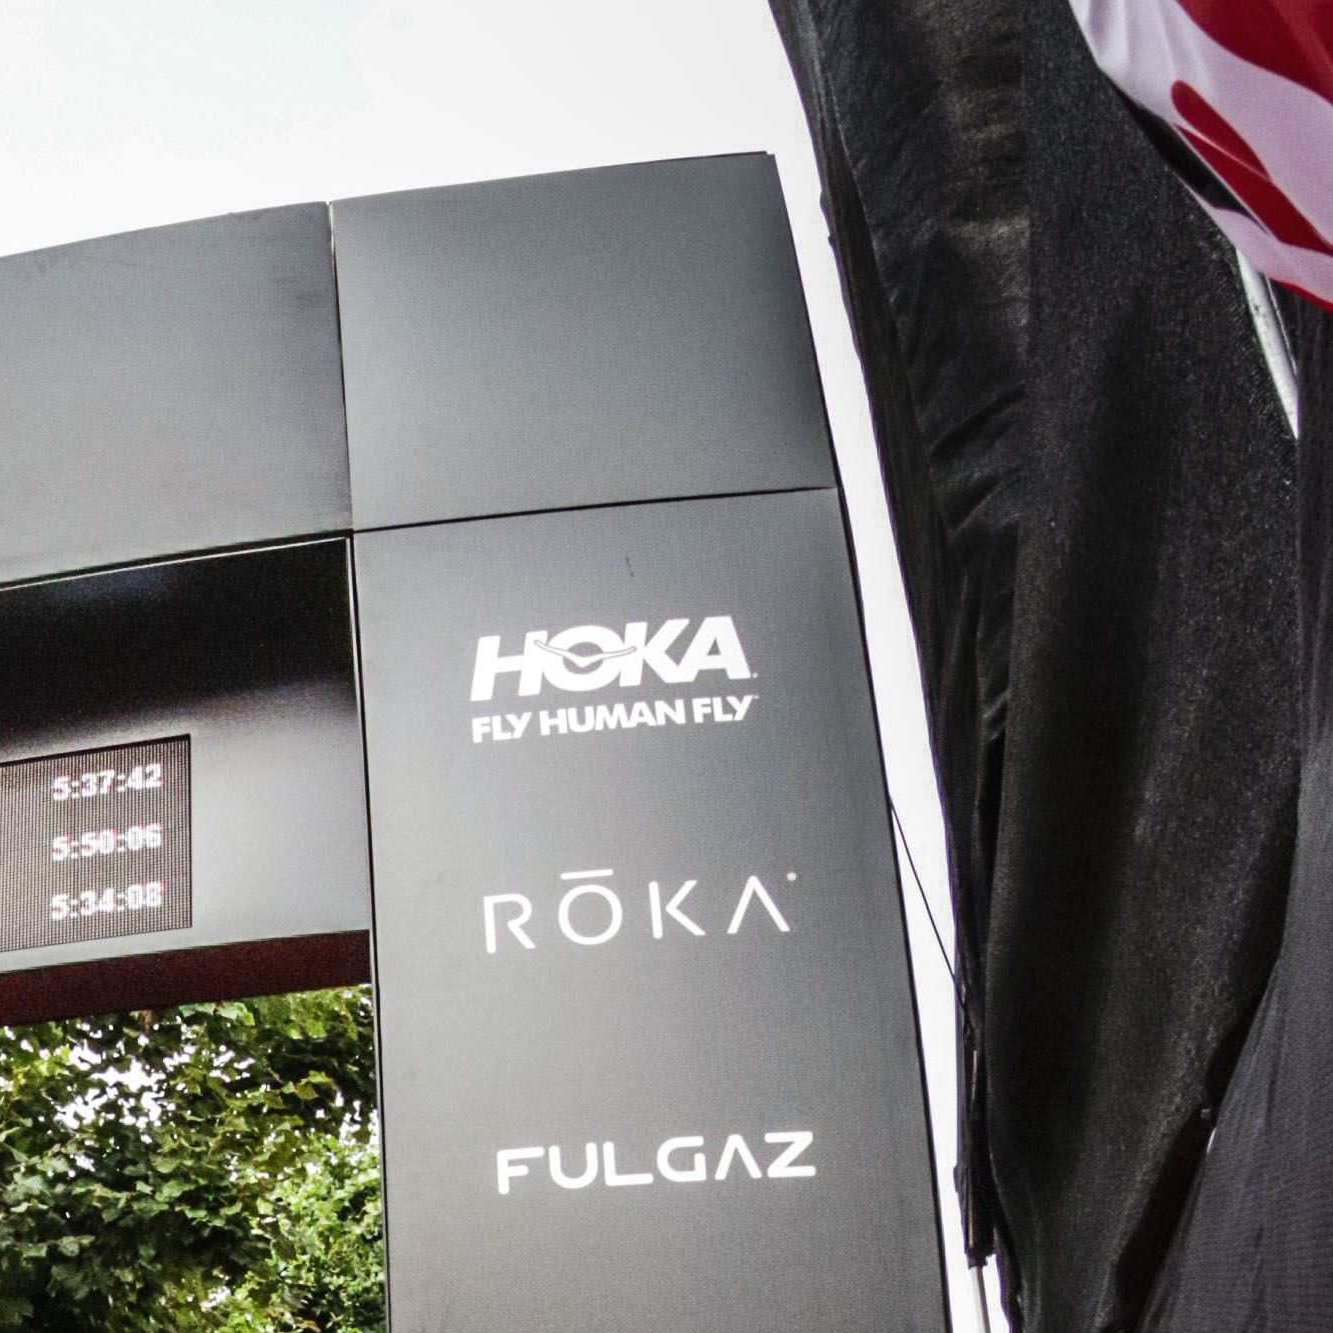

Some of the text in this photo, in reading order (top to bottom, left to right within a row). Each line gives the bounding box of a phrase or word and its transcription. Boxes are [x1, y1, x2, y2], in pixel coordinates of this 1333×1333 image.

[470, 616, 751, 701] HOKA
[471, 696, 754, 743] FLY HUMAN FLY
[53, 763, 163, 800] 5:37:42
[52, 822, 163, 861] 5:50:06
[51, 881, 163, 920] 5:34:08
[496, 1131, 816, 1194] FULGAZ
